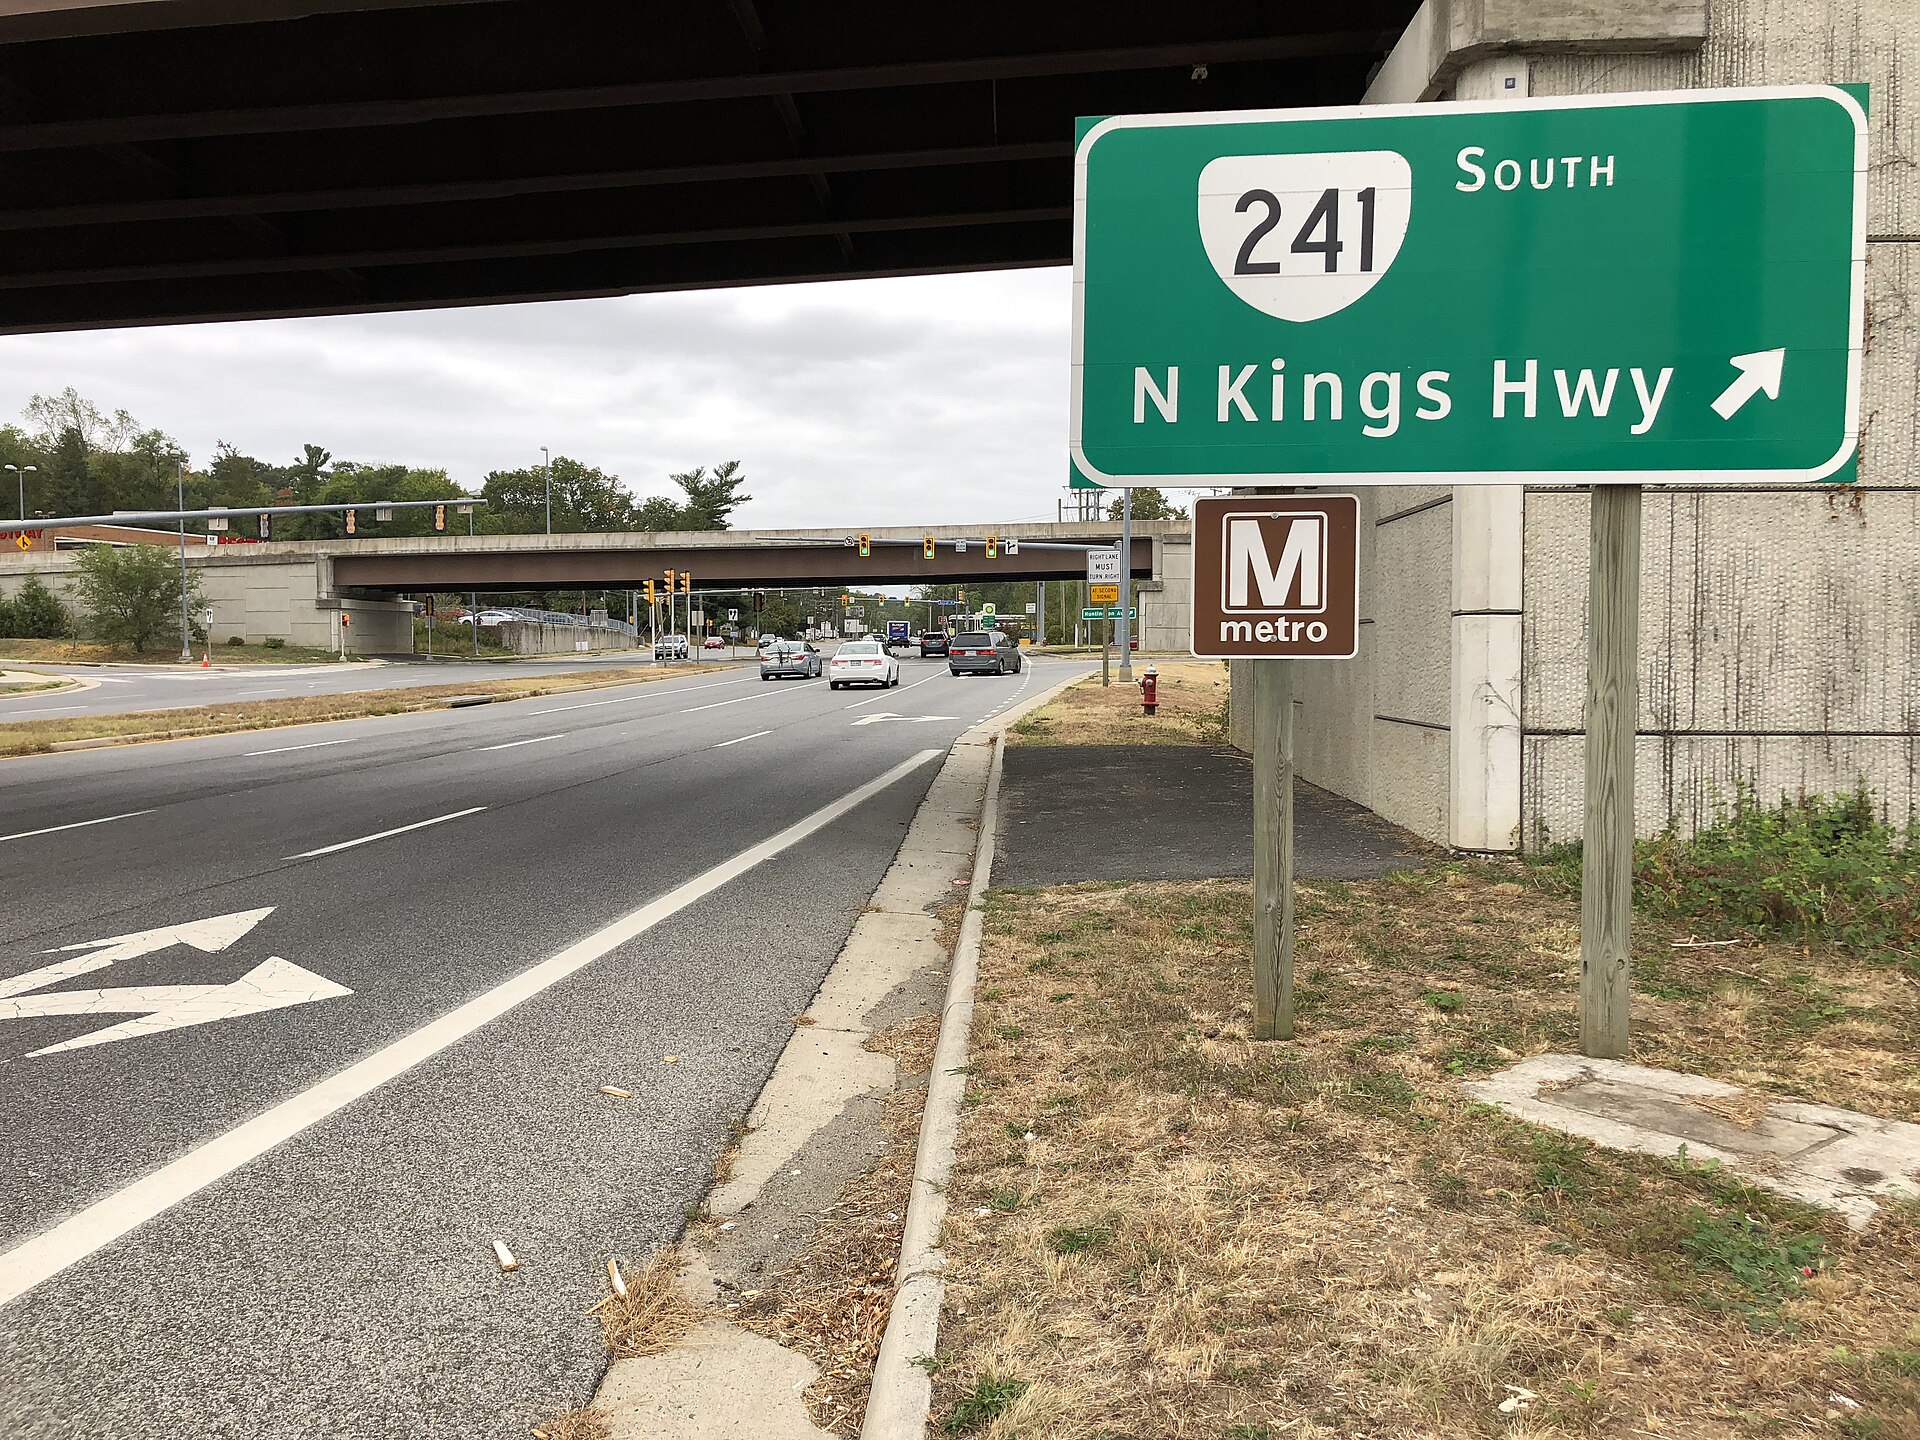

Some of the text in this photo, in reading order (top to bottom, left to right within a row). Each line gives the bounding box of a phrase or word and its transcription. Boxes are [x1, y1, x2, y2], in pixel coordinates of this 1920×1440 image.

[1455, 146, 1616, 192] SOUTH
[1233, 186, 1377, 275] 241
[1133, 357, 1675, 438] N Kings Hwy
[1229, 519, 1320, 606] M
[1219, 615, 1328, 642] metro
